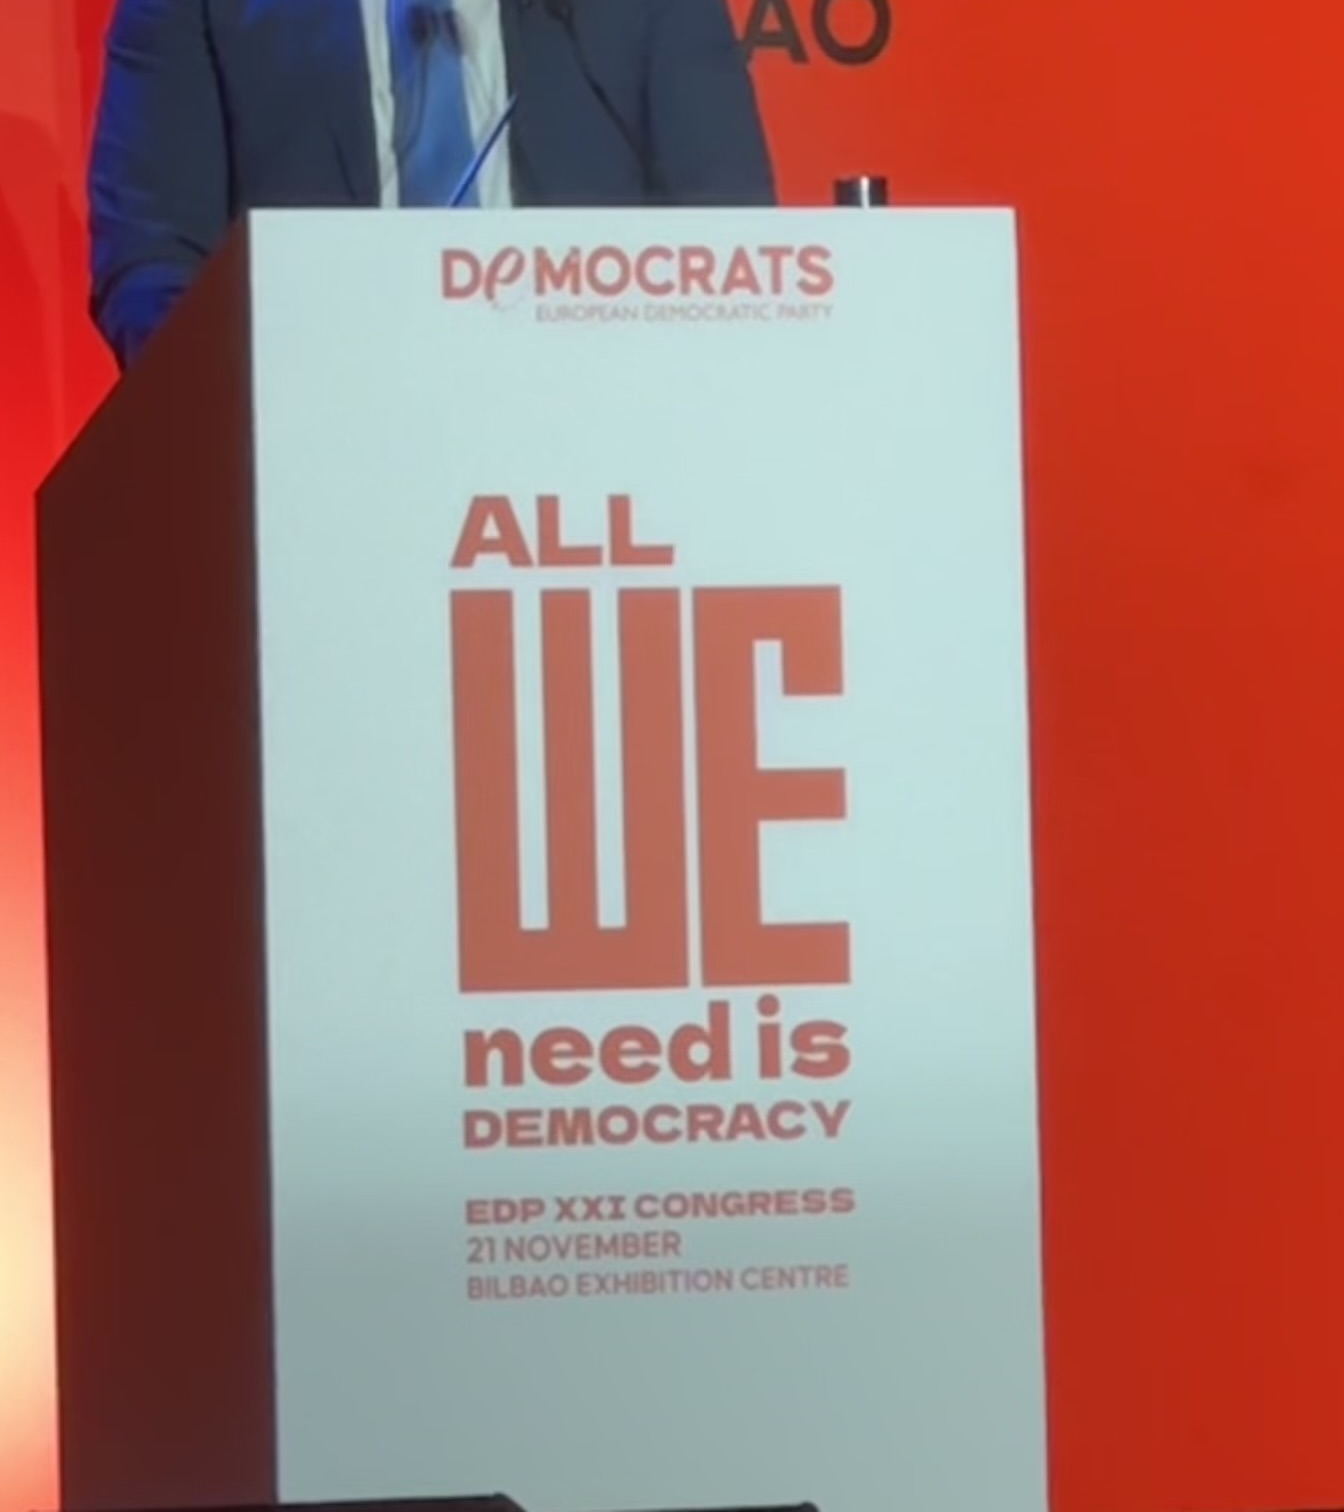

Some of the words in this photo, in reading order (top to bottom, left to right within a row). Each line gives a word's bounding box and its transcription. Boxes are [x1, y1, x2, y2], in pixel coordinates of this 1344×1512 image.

[535, 303, 639, 323] EUROPEAN
[643, 303, 771, 322] DEMOCRATIC
[776, 302, 833, 321] PARTY
[450, 493, 675, 569] ALL
[450, 585, 851, 993] WE
[463, 1000, 732, 1089] need
[756, 994, 851, 1079] is
[463, 1100, 851, 1149] DEMOCRACY
[465, 1197, 545, 1225] EDP
[553, 1195, 626, 1222] XXI
[633, 1187, 856, 1219] CONGRESS
[466, 1236, 497, 1264] 21
[504, 1230, 682, 1262] NOVEMBER
[467, 1274, 569, 1301] BILBAO
[576, 1268, 734, 1297] EXHIBITION
[739, 1263, 850, 1291] CENTRE
